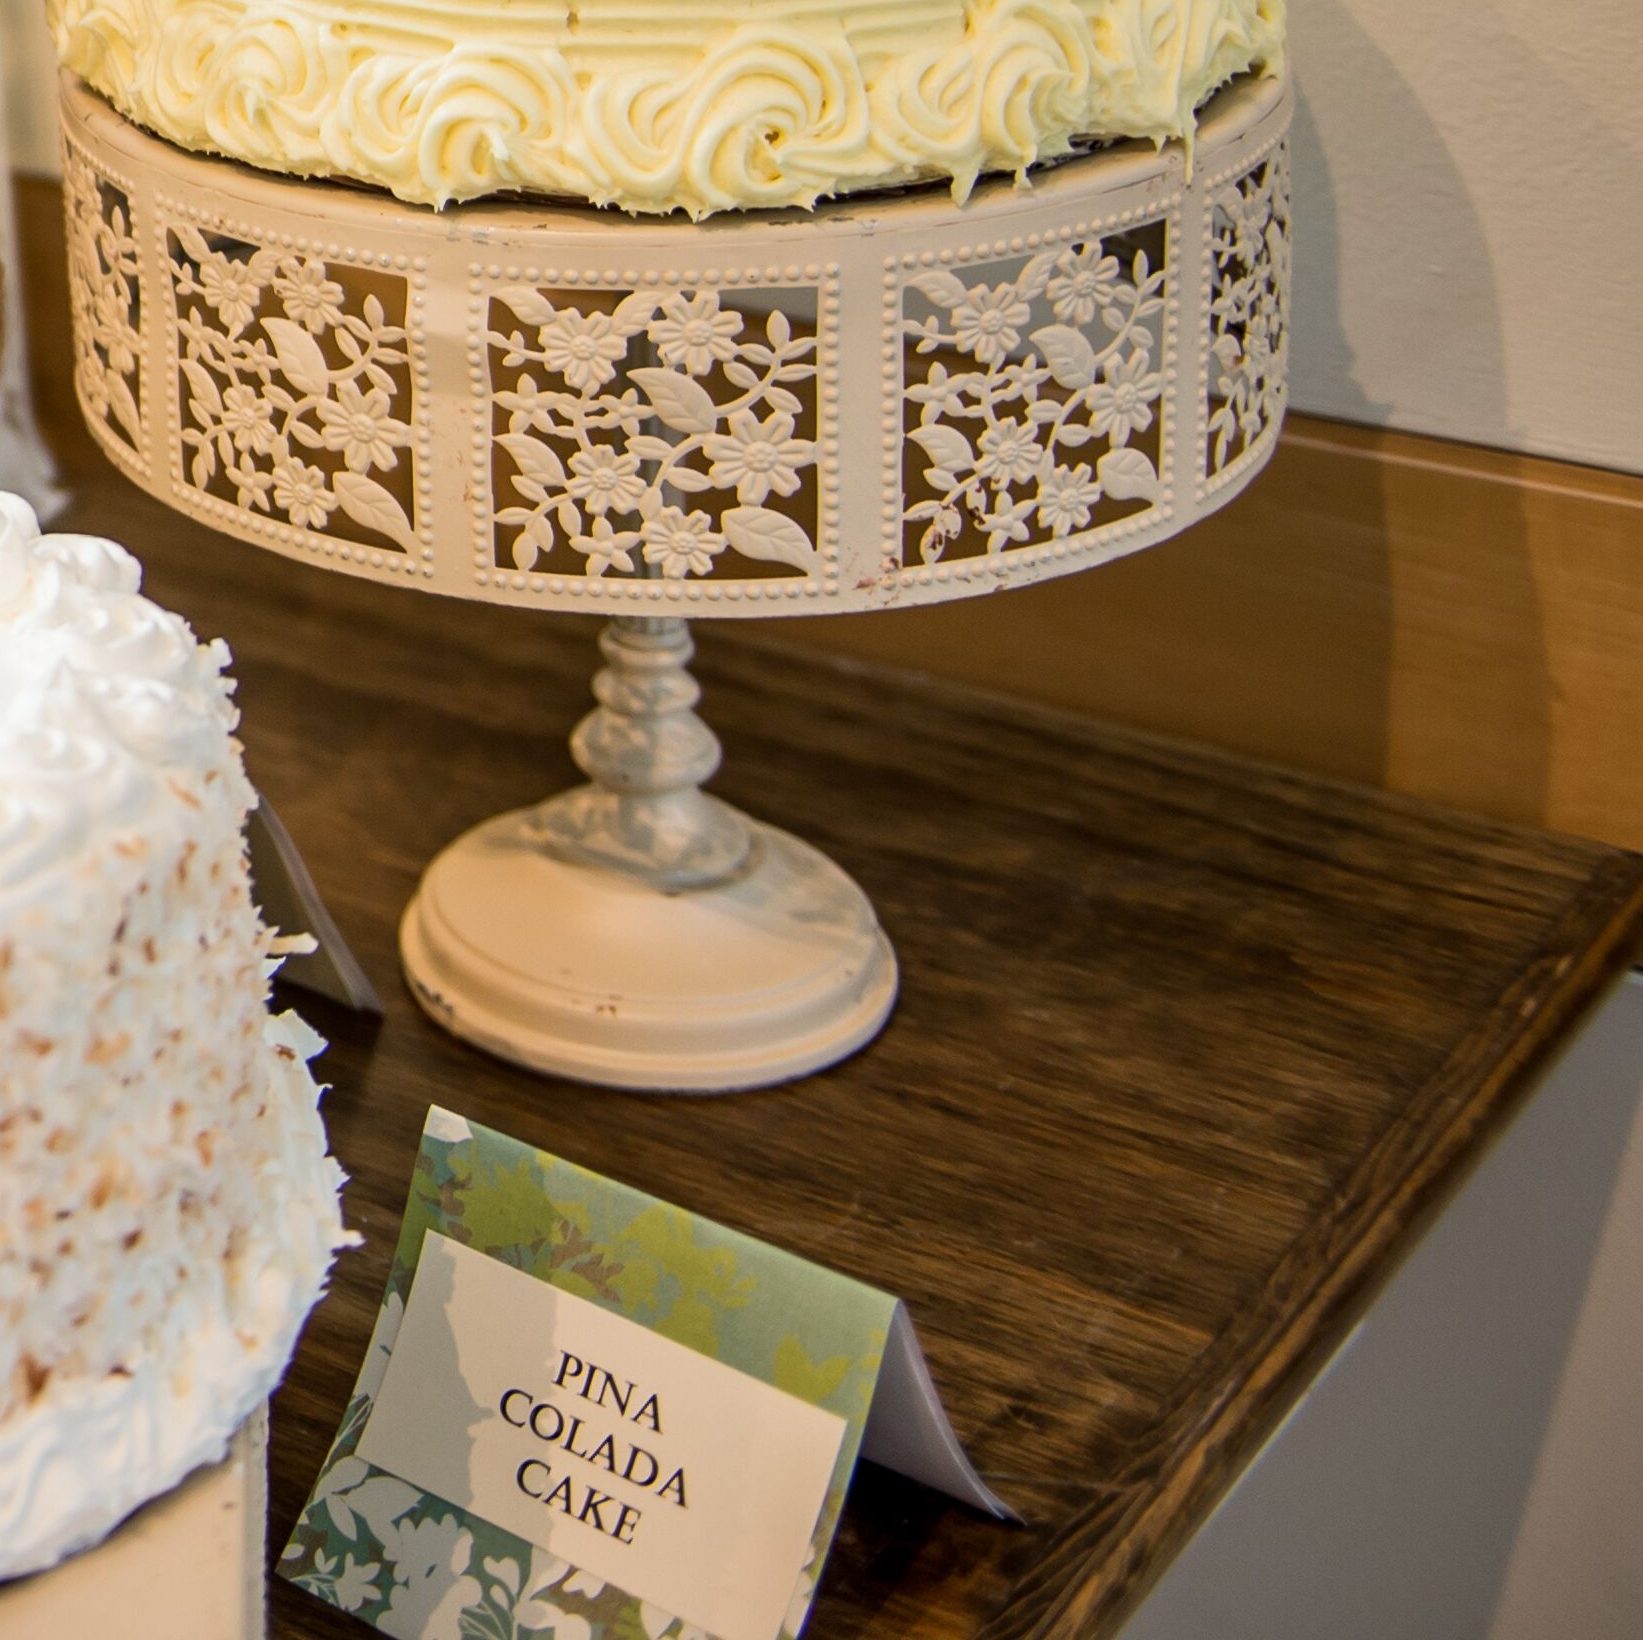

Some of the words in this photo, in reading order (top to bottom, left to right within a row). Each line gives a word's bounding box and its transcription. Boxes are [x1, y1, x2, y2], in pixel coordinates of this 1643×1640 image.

[552, 1350, 663, 1434] PINA
[499, 1388, 689, 1509] COLADA
[515, 1459, 643, 1546] CAKE
